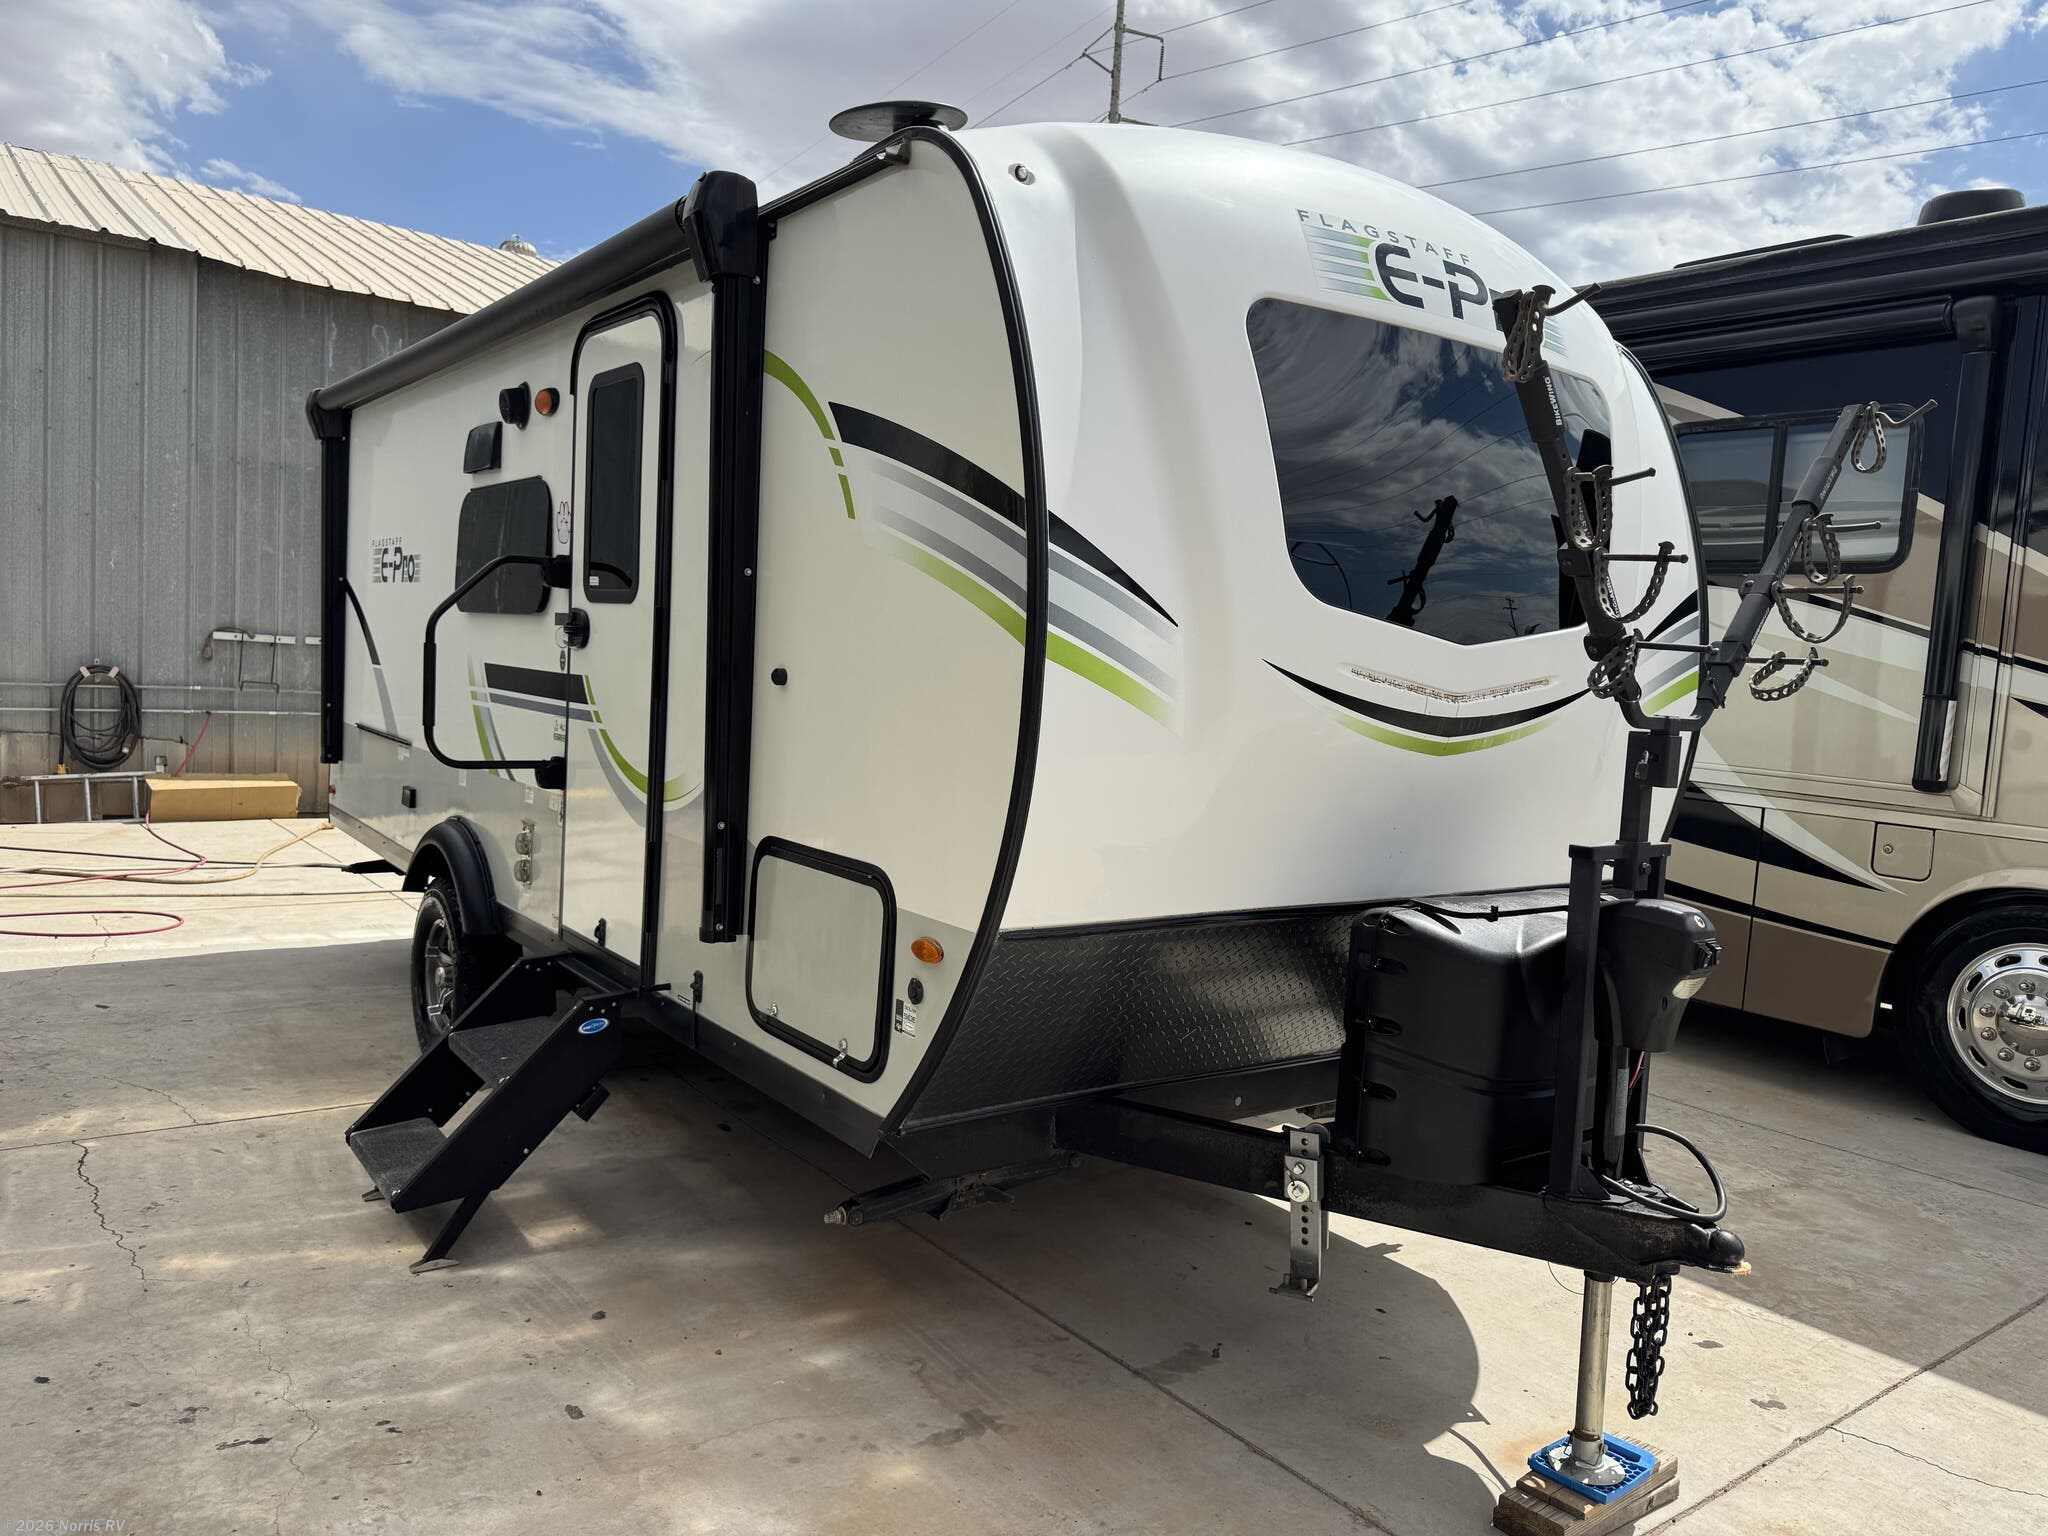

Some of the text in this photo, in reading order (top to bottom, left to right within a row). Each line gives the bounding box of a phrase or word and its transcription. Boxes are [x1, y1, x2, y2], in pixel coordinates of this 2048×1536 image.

[1297, 208, 1470, 265] FLAGSTAFF
[1375, 242, 1504, 332] E-P
[1544, 376, 1563, 426] BIKEWING
[381, 546, 415, 583] E-Pro
